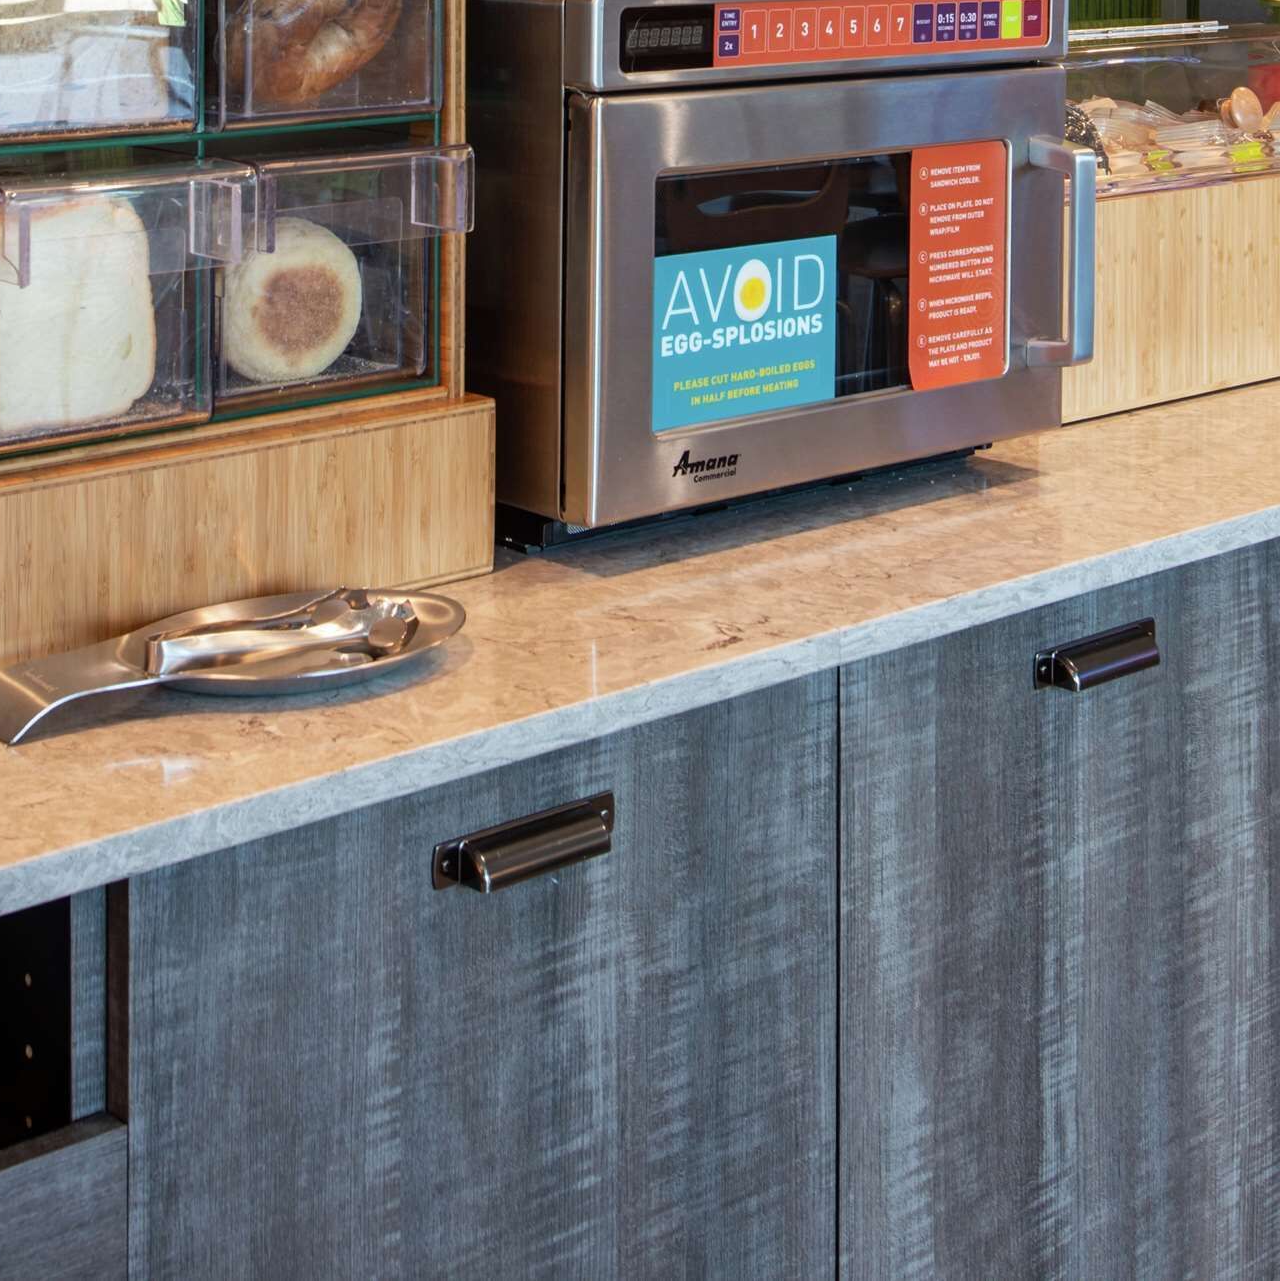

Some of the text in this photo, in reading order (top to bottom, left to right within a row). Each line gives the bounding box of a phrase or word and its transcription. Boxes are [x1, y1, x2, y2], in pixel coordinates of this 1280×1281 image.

[722, 19, 737, 27] ENTRY
[938, 14, 954, 24] 0:15
[960, 12, 976, 23] 0:30
[752, 25, 757, 39] 1
[776, 23, 783, 38] 2
[802, 22, 809, 36] 3
[826, 20, 833, 35] 4
[850, 19, 857, 34] 5
[874, 18, 880, 32] 6
[897, 17, 904, 31] 7
[930, 167, 952, 176] REMOVE
[966, 164, 981, 172] FROM
[930, 179, 958, 188] SANDWICH
[930, 203, 947, 212] PLACE
[930, 210, 984, 224] REMOVE FROM OUTER
[930, 250, 947, 260] PRESS
[929, 262, 959, 272] NUMBERED
[960, 259, 980, 268] BUTTON
[929, 273, 960, 283] MICROWAVE
[662, 254, 825, 331] AVOID
[929, 299, 944, 308] WHEN
[929, 310, 953, 320] PRODUCT
[661, 313, 823, 357] EGG-SPLOSIONS
[928, 334, 951, 343] REMOVE
[952, 329, 983, 339] CAREFULLY
[929, 347, 939, 356] THE
[940, 345, 956, 354] PLATE
[968, 338, 992, 348] PRODUCT
[929, 359, 940, 368] MAY
[674, 359, 816, 392] PLEASE CUT HARD-BOILED EGGS
[691, 379, 799, 406] IN HALF BEFORE HEATING
[672, 450, 738, 477] Amana
[693, 468, 737, 484] Commercial
